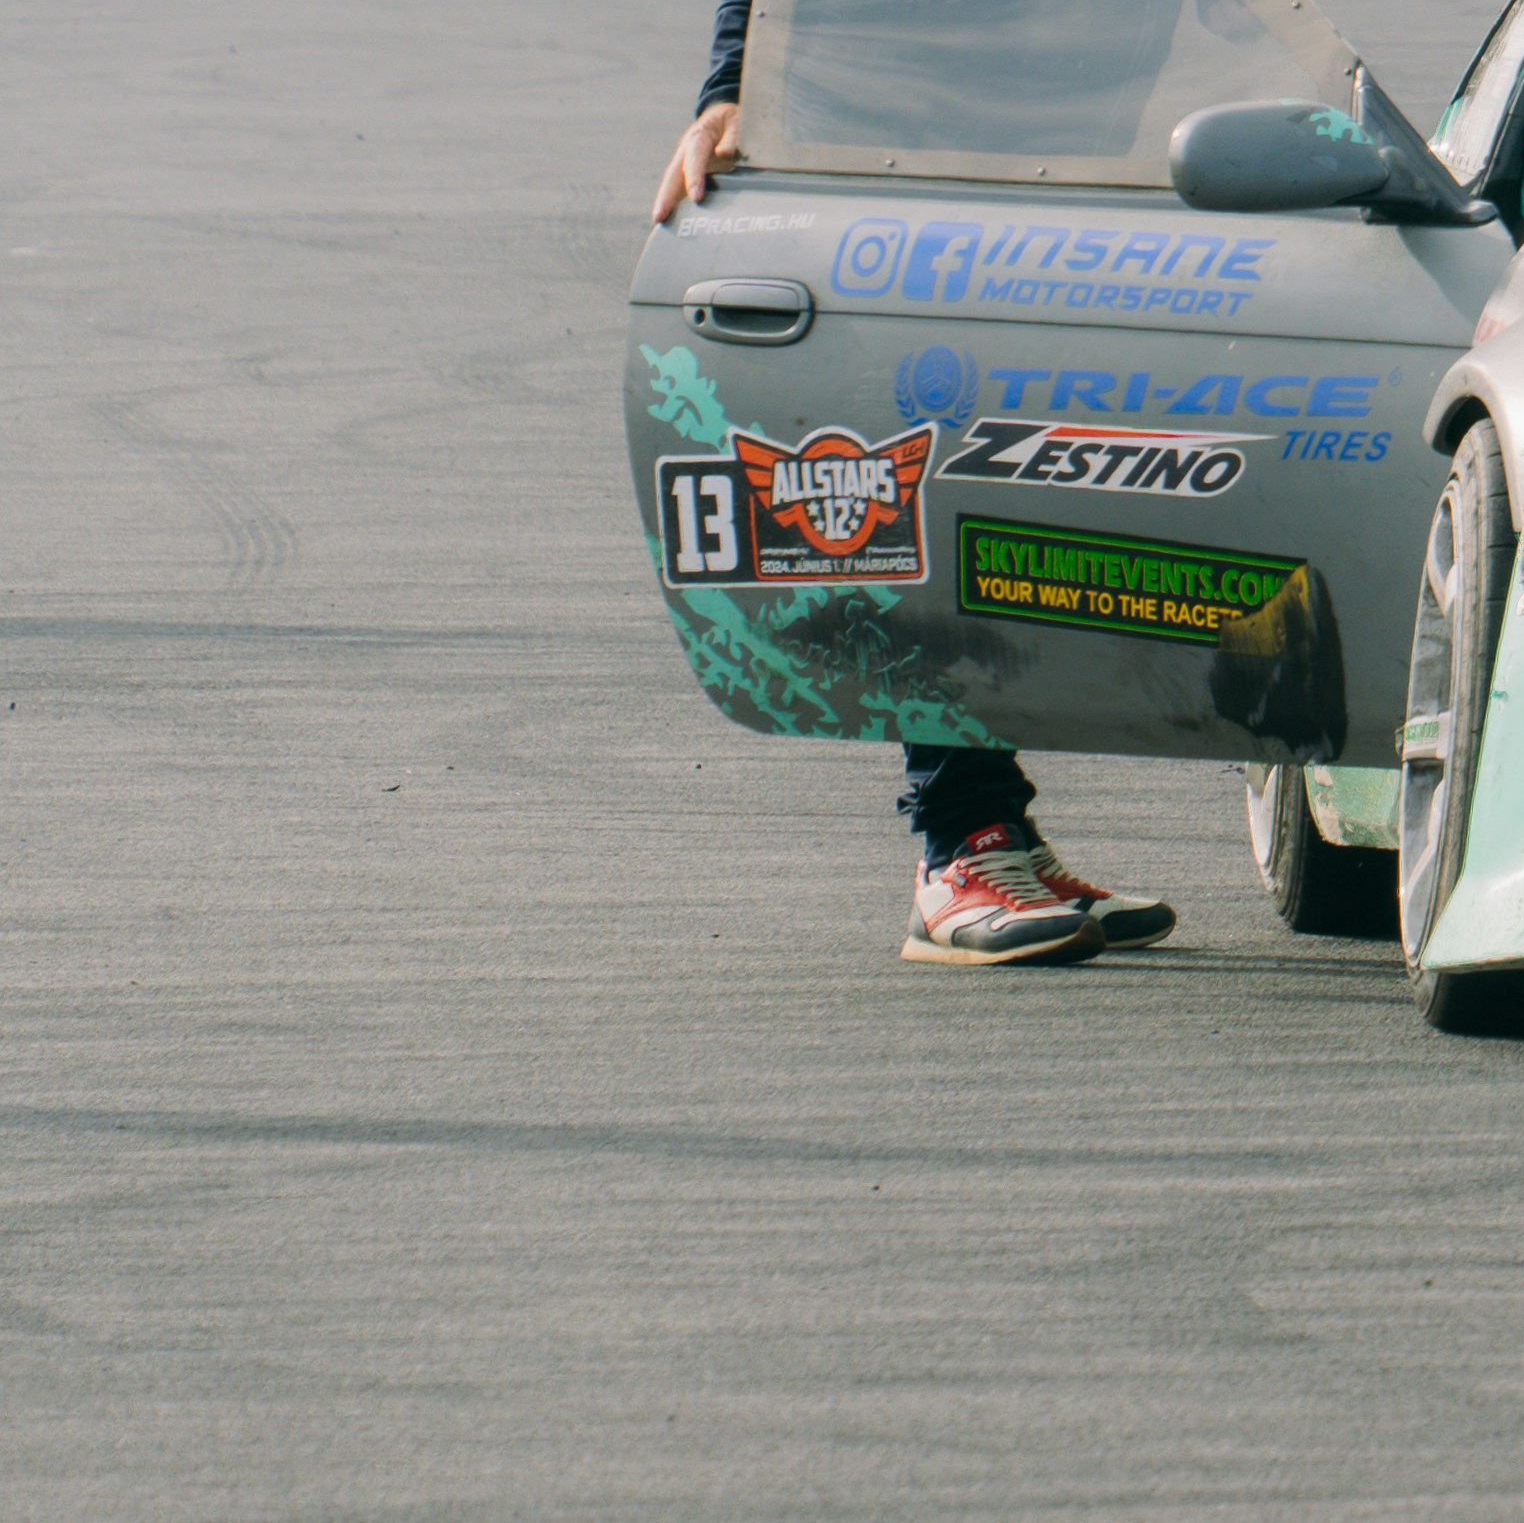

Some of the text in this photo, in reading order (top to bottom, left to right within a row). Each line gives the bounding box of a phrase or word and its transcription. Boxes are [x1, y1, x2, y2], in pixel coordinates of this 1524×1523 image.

[677, 212, 816, 238] BPRACING.HU
[981, 224, 1278, 281] INSANE
[978, 277, 1256, 317] MOTORSPORT
[987, 368, 1381, 418] TRI-ACE
[942, 419, 1243, 494] ZESTINO
[1281, 430, 1392, 463] TIRES
[771, 458, 896, 506] ALLSTARS
[671, 474, 739, 573] 13
[823, 497, 851, 541] 12
[976, 576, 1033, 604] YOUR
[1038, 583, 1082, 611] WAY
[1085, 590, 1114, 614] TO
[1118, 595, 1158, 621] THE
